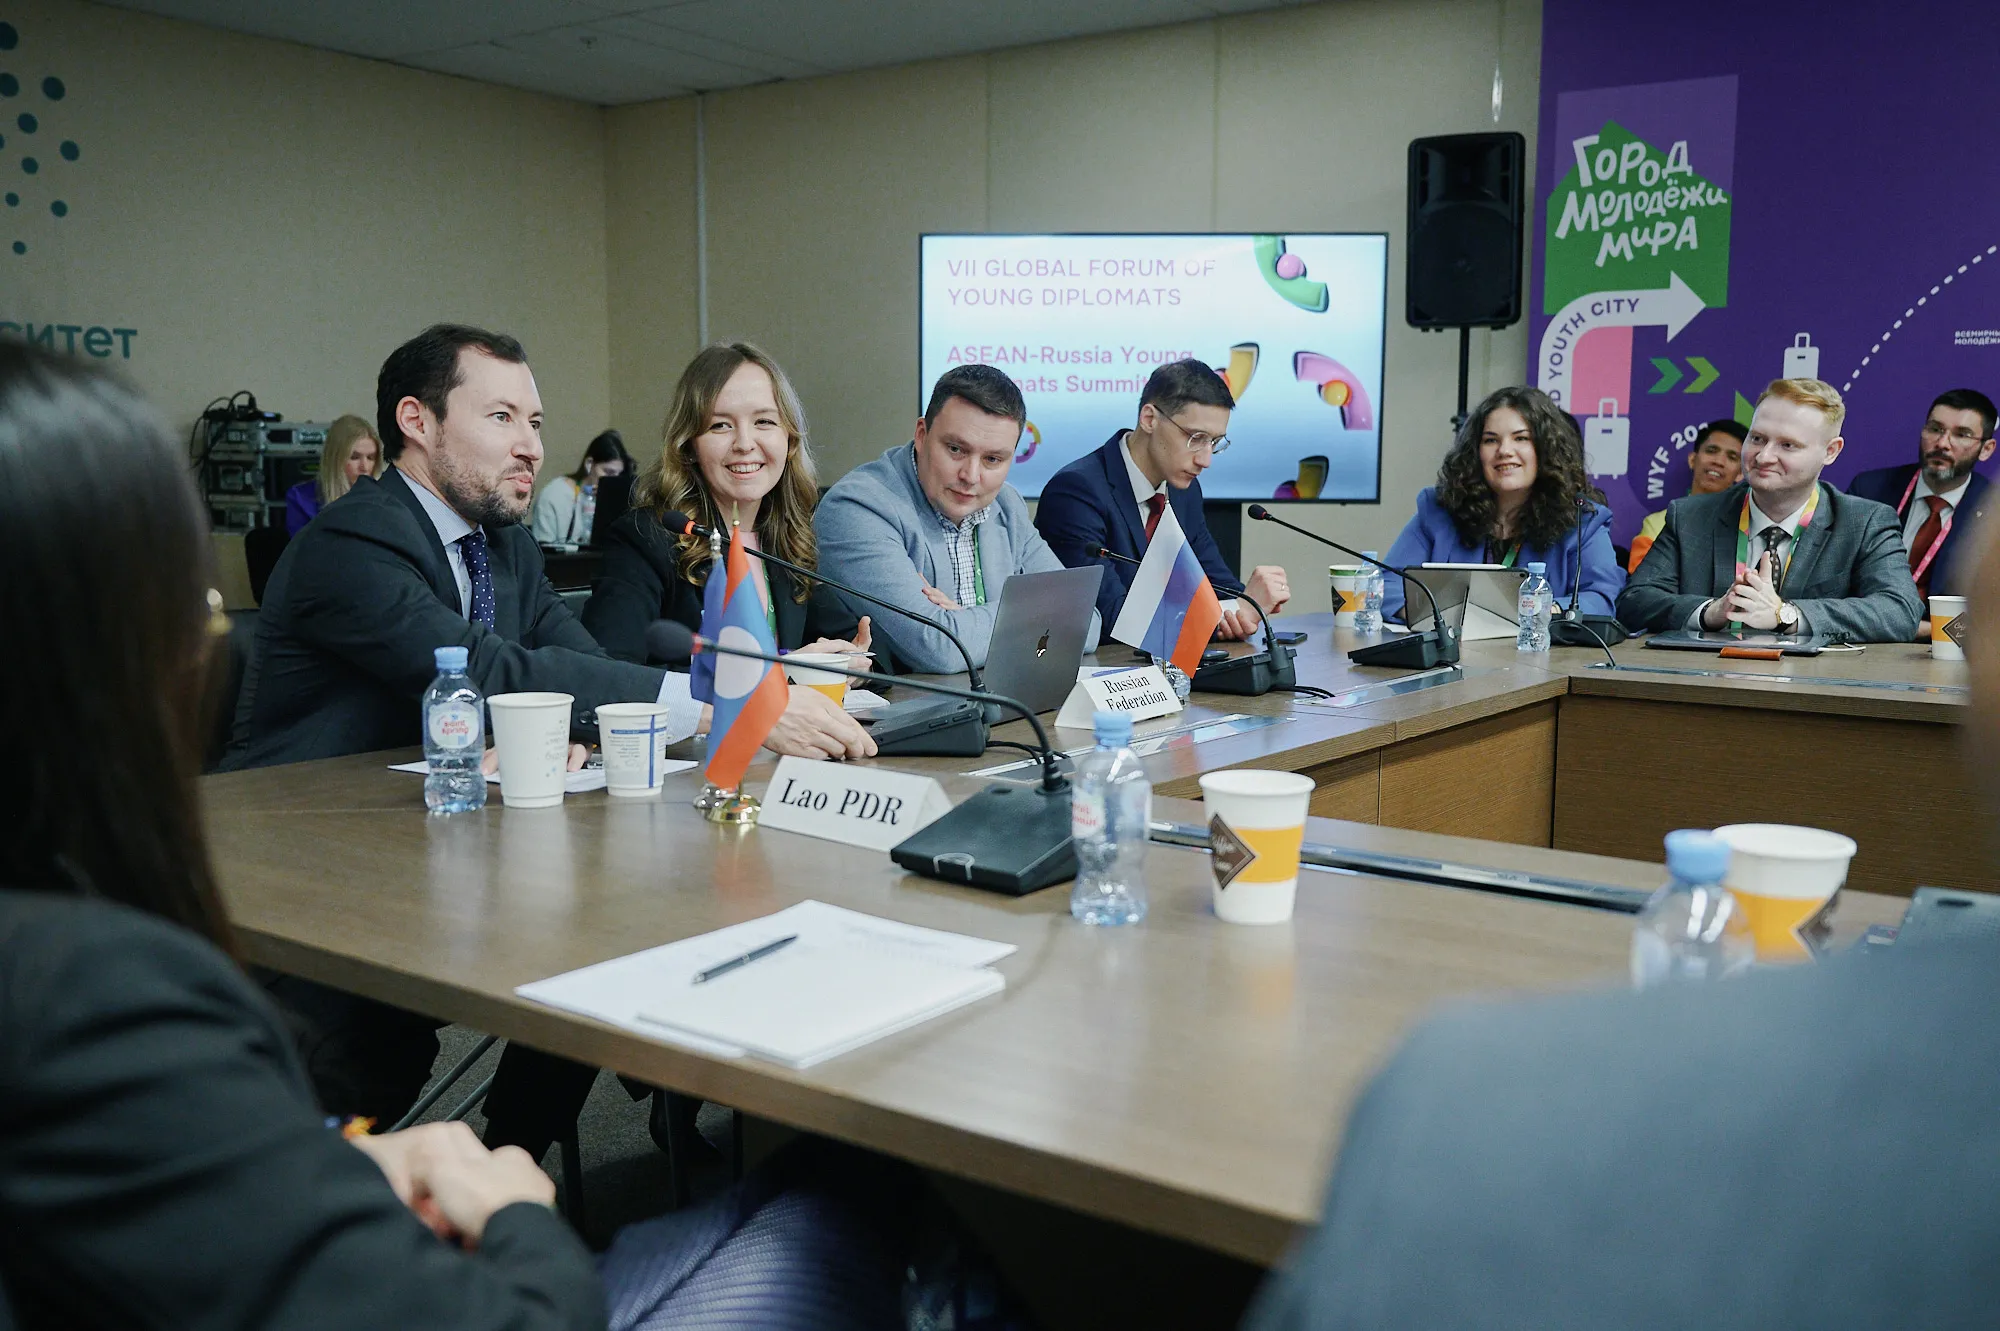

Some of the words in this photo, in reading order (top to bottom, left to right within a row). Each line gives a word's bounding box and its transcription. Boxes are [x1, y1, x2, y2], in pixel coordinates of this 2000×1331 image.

[948, 259, 976, 276] VII
[985, 259, 1081, 277] GLOBAL
[1089, 259, 1174, 277] FORUM
[1184, 259, 1216, 277] OF
[948, 288, 1033, 306] YOUNG
[1042, 288, 1181, 306] DIPLOMATS
[1548, 312, 1586, 380] YOUTH
[1591, 298, 1640, 316] CITY
[947, 345, 1113, 364] ASEAN-Russia
[1647, 446, 1670, 499] WYF
[1102, 675, 1151, 694] Russian
[1105, 690, 1168, 712] Federation
[779, 778, 828, 811] Lao
[836, 788, 903, 825] PDR
